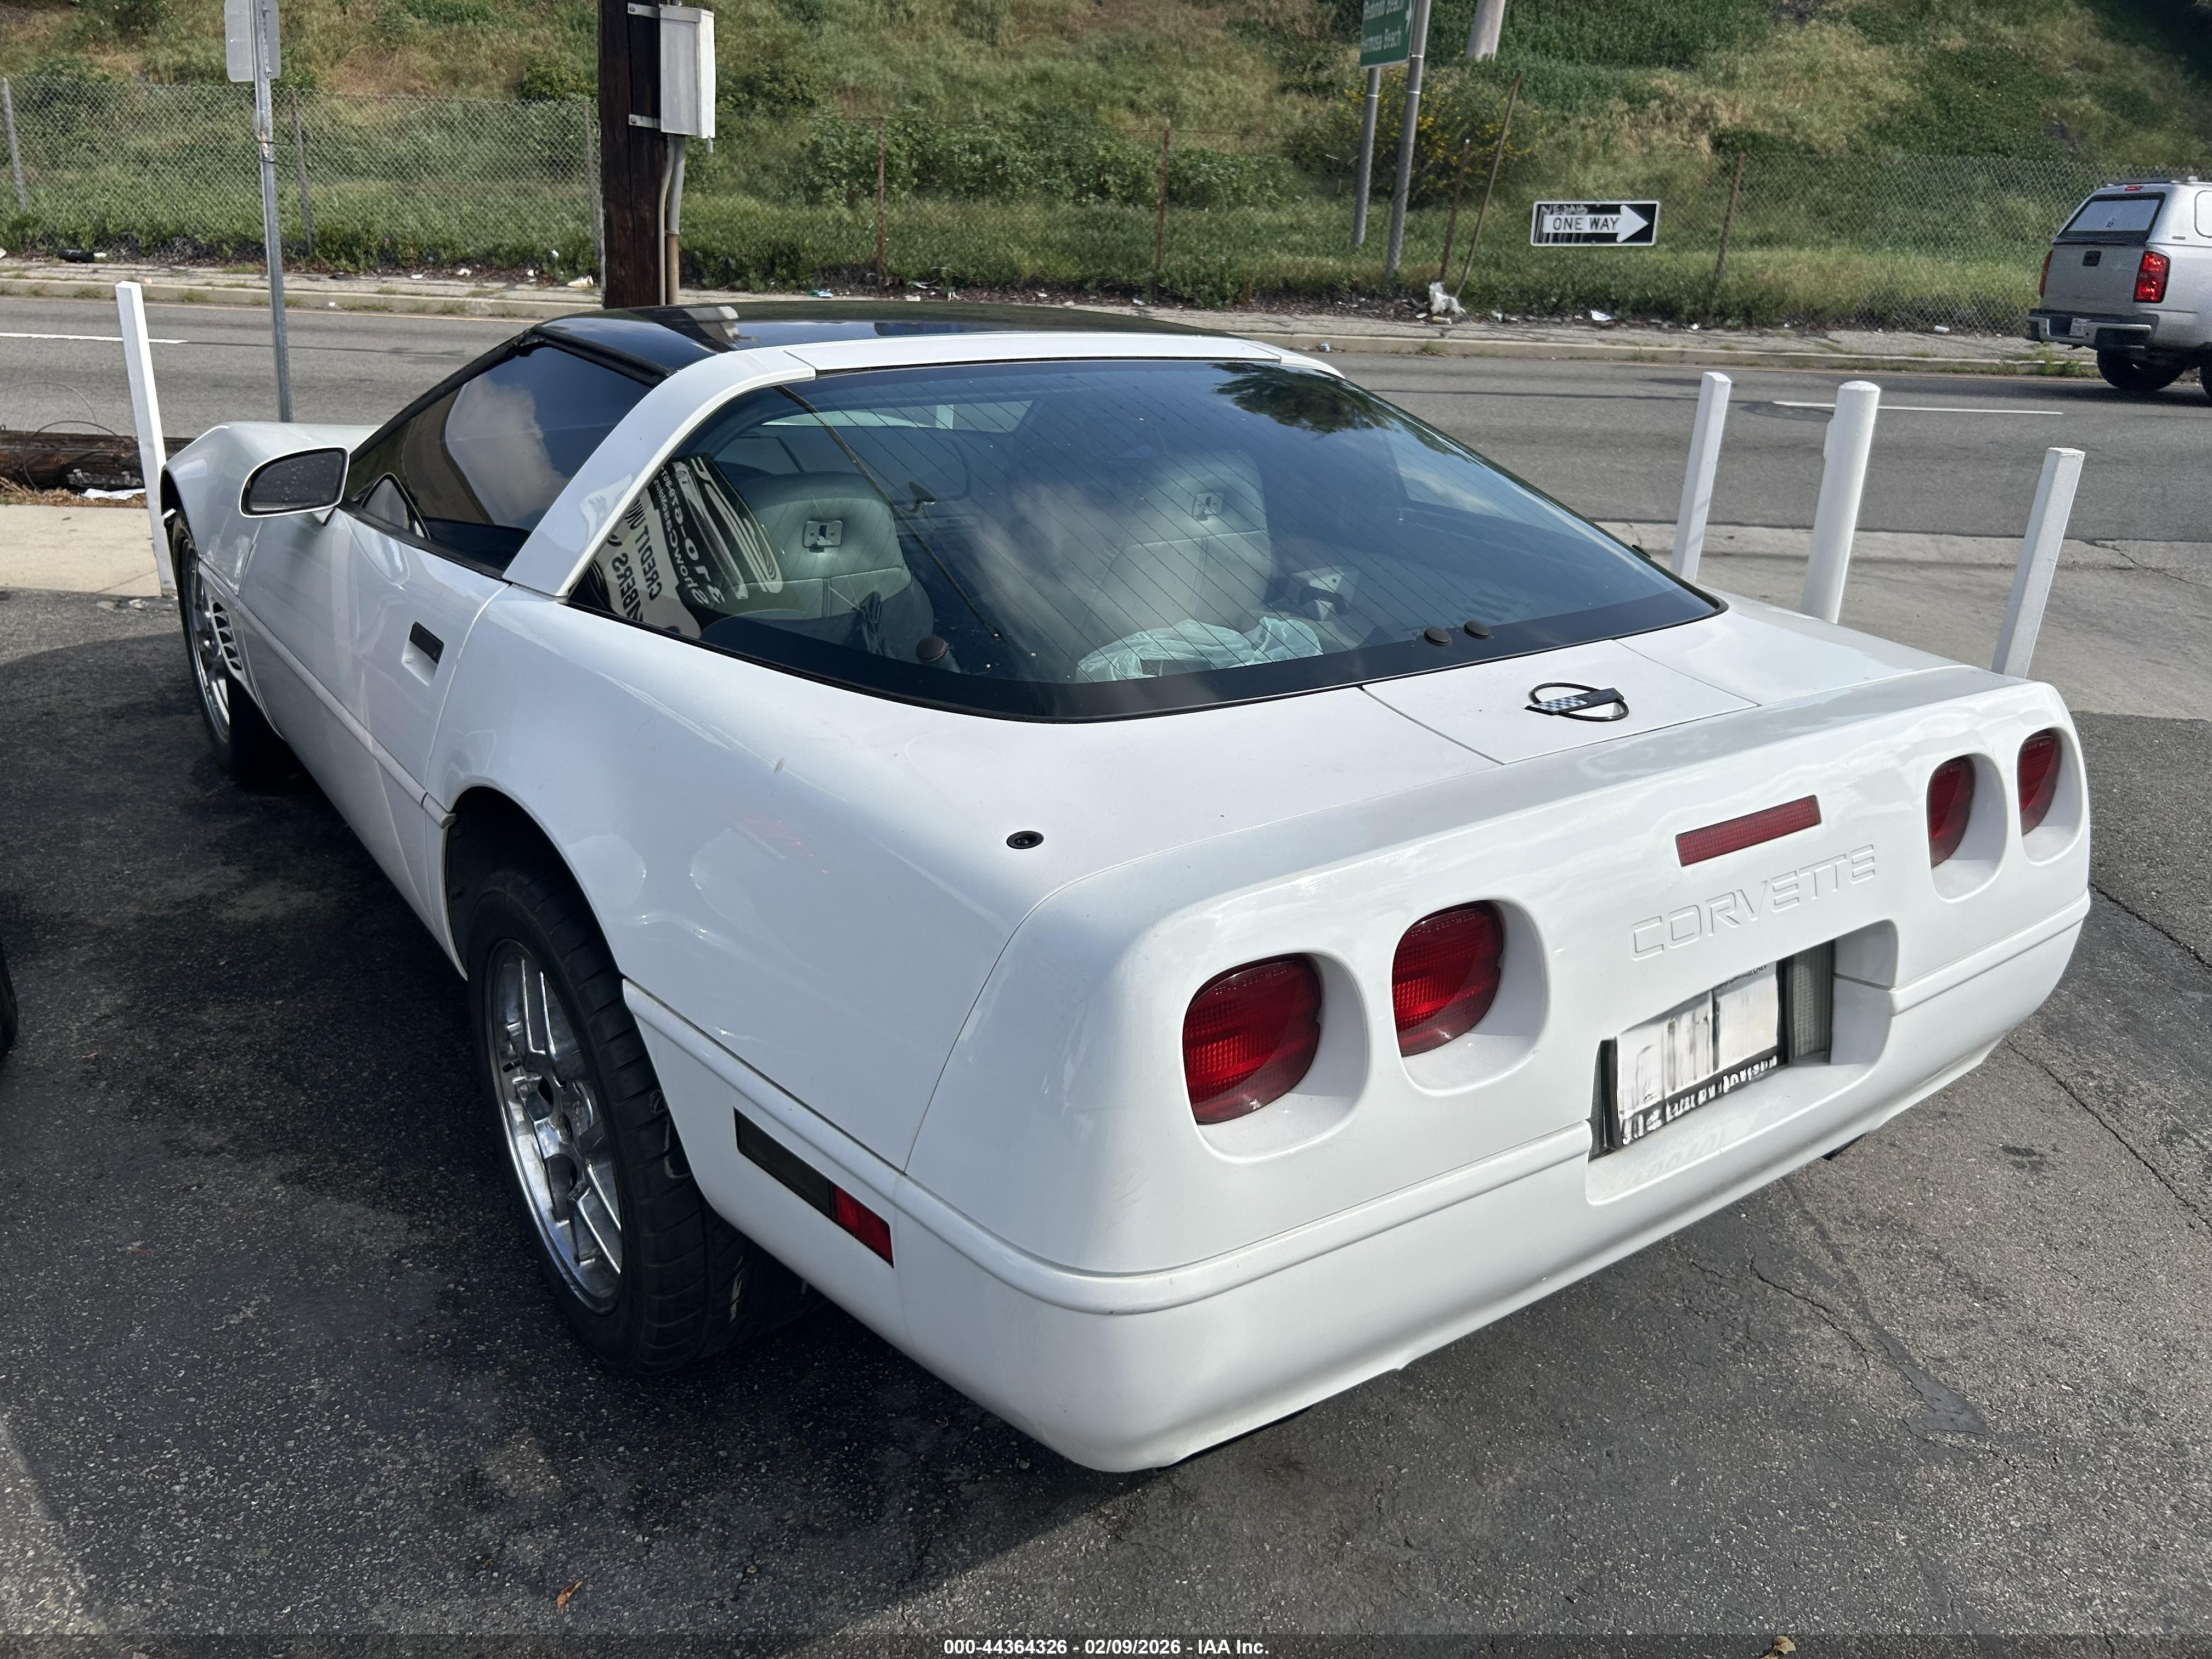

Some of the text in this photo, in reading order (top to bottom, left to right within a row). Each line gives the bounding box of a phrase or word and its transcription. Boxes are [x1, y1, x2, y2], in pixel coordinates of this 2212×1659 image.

[1553, 217, 1620, 231] ONE WAY
[1630, 844, 1875, 961] CORVETTE
